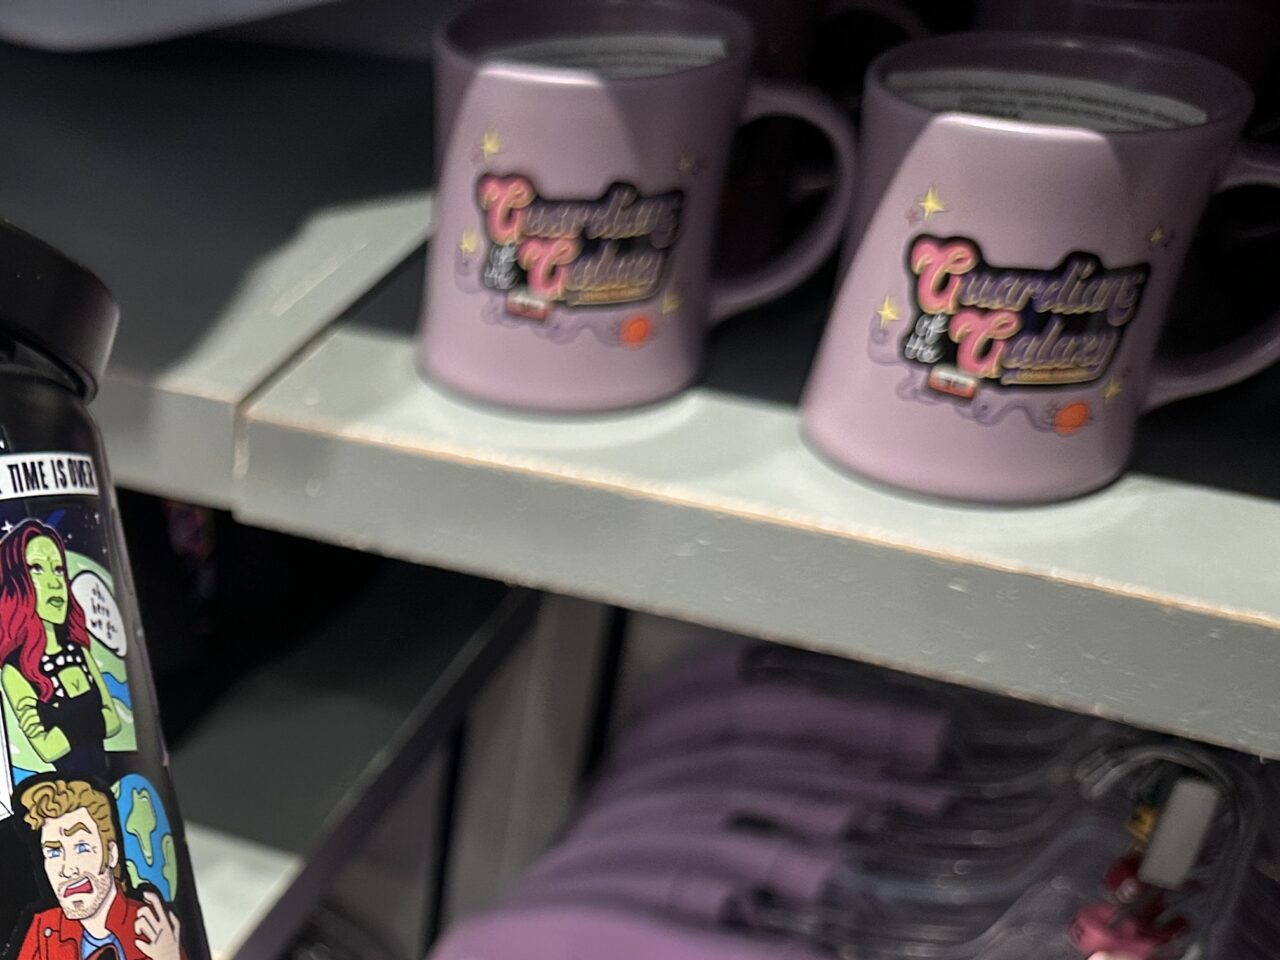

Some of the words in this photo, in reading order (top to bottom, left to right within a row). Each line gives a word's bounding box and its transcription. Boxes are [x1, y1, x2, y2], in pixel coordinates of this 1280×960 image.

[7, 460, 49, 494] TIME
[52, 459, 67, 490] IS
[68, 457, 96, 490] OVER
